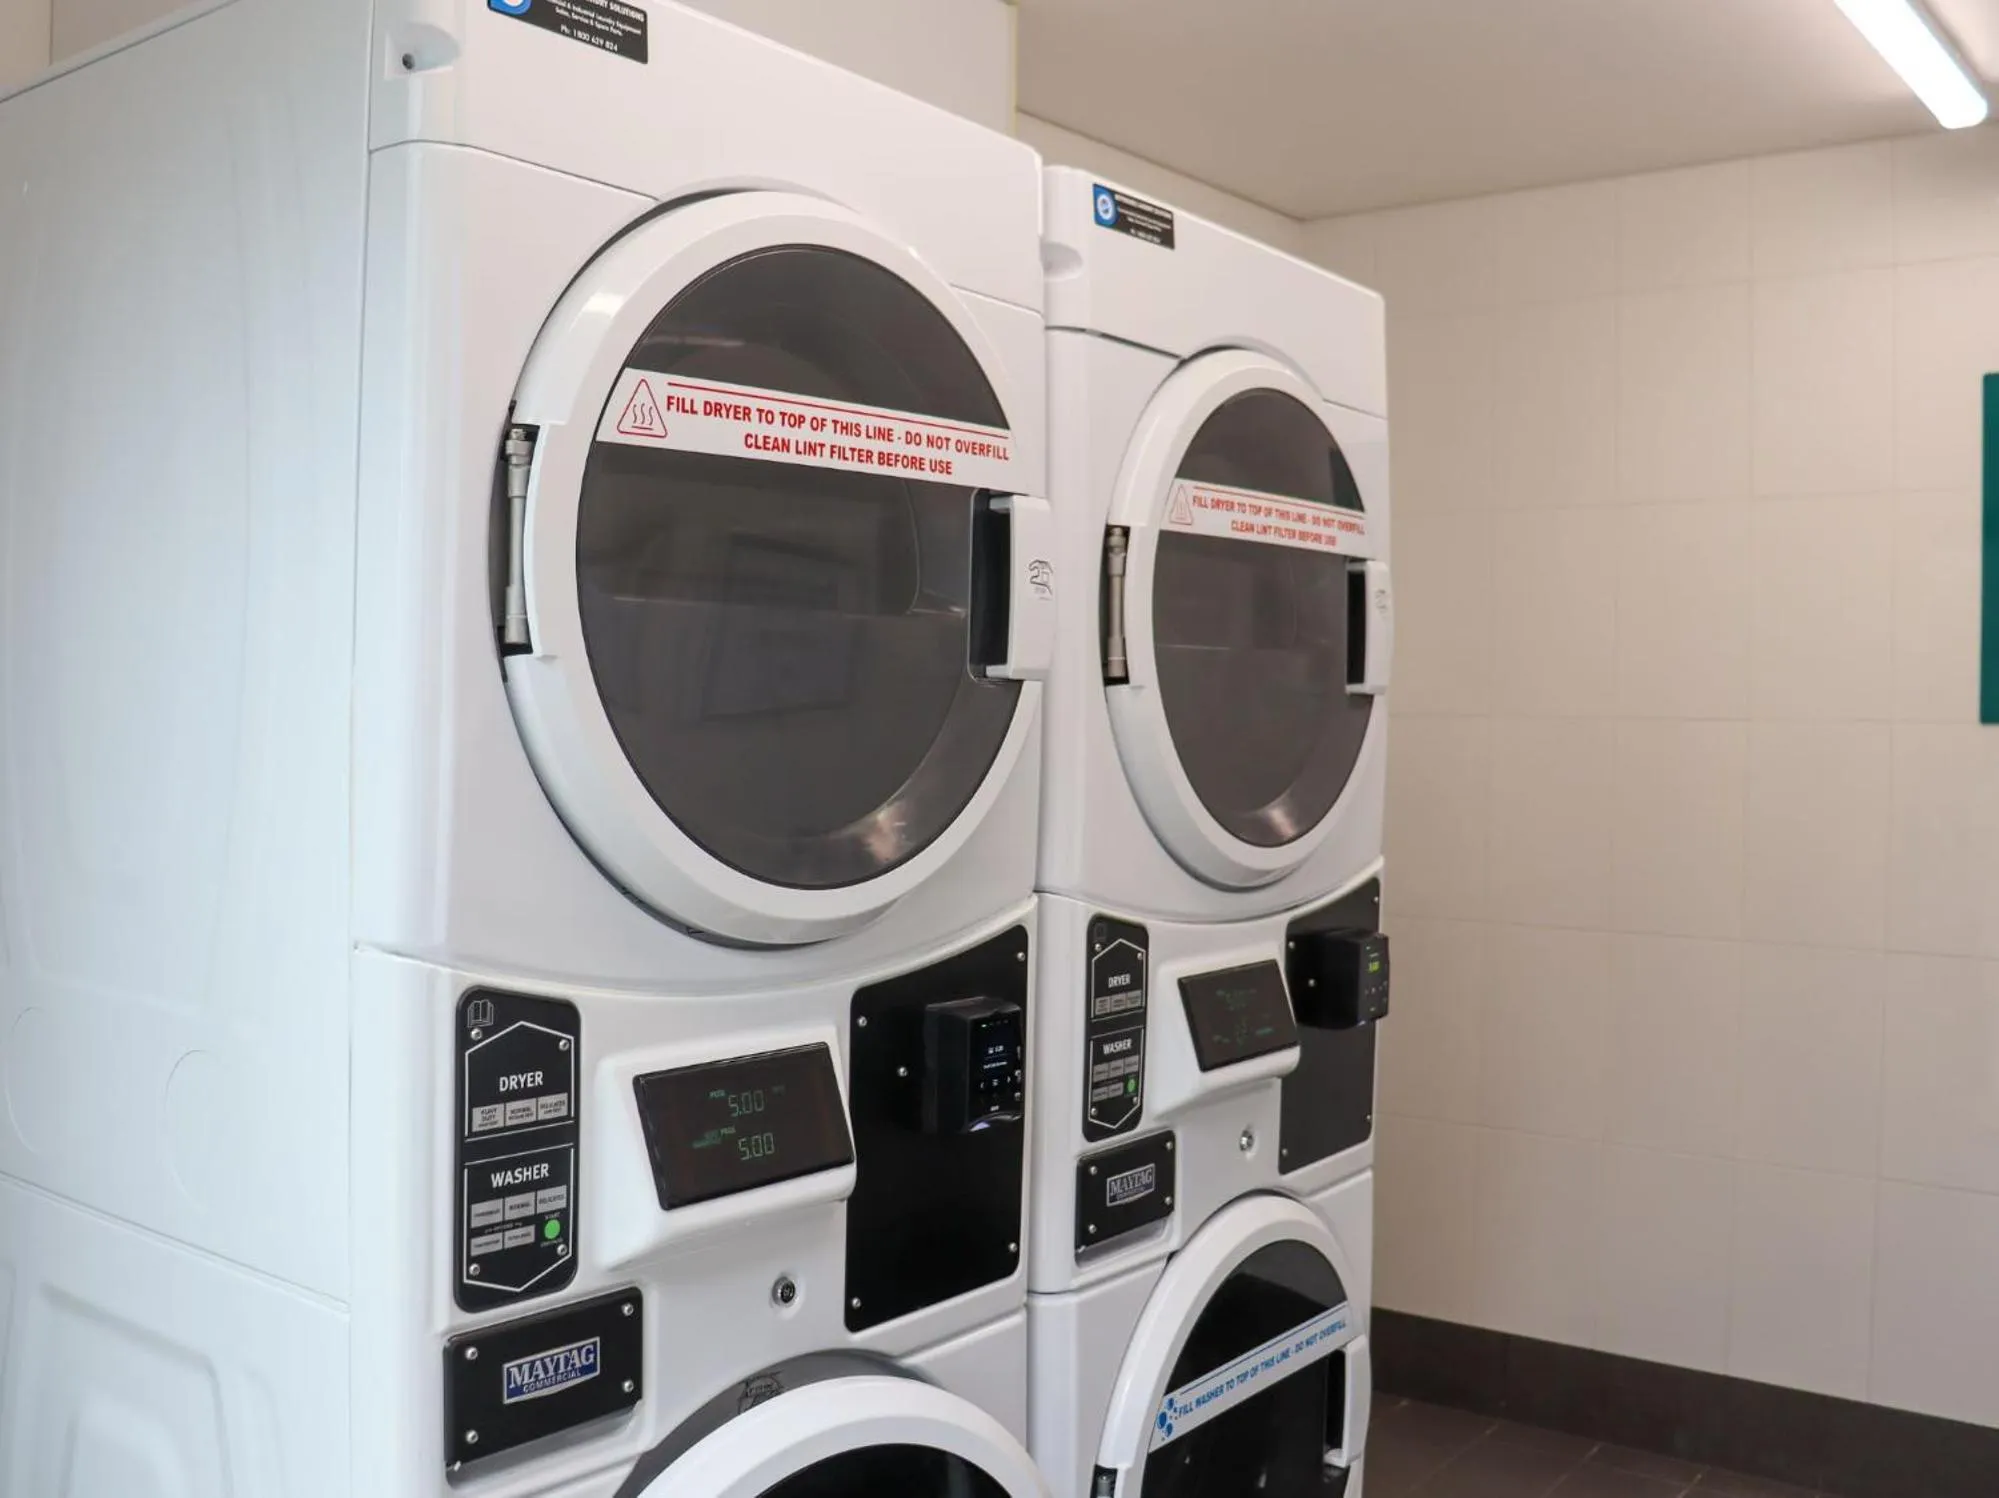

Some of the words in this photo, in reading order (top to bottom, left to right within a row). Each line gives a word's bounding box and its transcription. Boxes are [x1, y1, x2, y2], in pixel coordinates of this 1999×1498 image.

[609, 2, 645, 22] SOLUTIONS
[574, 29, 589, 41] 1800
[667, 395, 698, 415] FILL
[703, 400, 752, 422] DRYER
[757, 408, 775, 426] TO
[780, 410, 806, 430] TOP
[810, 415, 828, 432] OF
[832, 420, 861, 438] THIS
[865, 424, 894, 443] LINE
[906, 430, 922, 446] DO
[926, 433, 950, 452] NOT
[955, 438, 1010, 460] OVERFILL
[744, 434, 790, 454] CLEAN
[795, 440, 824, 459] LINT
[829, 445, 874, 465] FILTER
[878, 451, 926, 472] BEFORE
[930, 458, 952, 475] USE
[1192, 496, 1208, 509] FILL
[1211, 498, 1236, 512] DRYER
[1237, 502, 1246, 514] TO
[1248, 504, 1262, 517] TOP
[1264, 507, 1274, 518] OF
[1275, 509, 1291, 522] THIS
[1292, 512, 1306, 524] LINE
[1311, 516, 1321, 526] DO
[1323, 518, 1336, 528] NOT
[1337, 520, 1365, 535] OVERFILL
[1231, 520, 1255, 533] CLEAN
[1256, 524, 1273, 536] LINT
[1274, 526, 1296, 540] FILTER
[1298, 530, 1323, 544] BEFORE
[1324, 534, 1337, 546] USE
[1108, 974, 1131, 988] DRYER
[1103, 1038, 1132, 1055] WASHER
[499, 1070, 544, 1092] DRYER
[729, 1090, 764, 1118] 5.00
[738, 1132, 774, 1160] 5.00
[490, 1163, 550, 1188] WASHER
[1110, 1168, 1152, 1196] MAYTAG
[508, 1344, 595, 1388] MAYTAG
[1178, 1402, 1194, 1418] FILL
[1195, 1386, 1225, 1409] WASHER
[1226, 1380, 1236, 1391] TO
[1236, 1371, 1250, 1384] TOP
[1250, 1366, 1260, 1377] OF
[1260, 1358, 1275, 1372] THIS
[1276, 1349, 1291, 1365] LINE
[1295, 1342, 1304, 1354] DO
[1306, 1334, 1318, 1349] NOT
[1319, 1319, 1346, 1340] OVERFILL
[523, 1369, 581, 1394] COMMERCIAL
